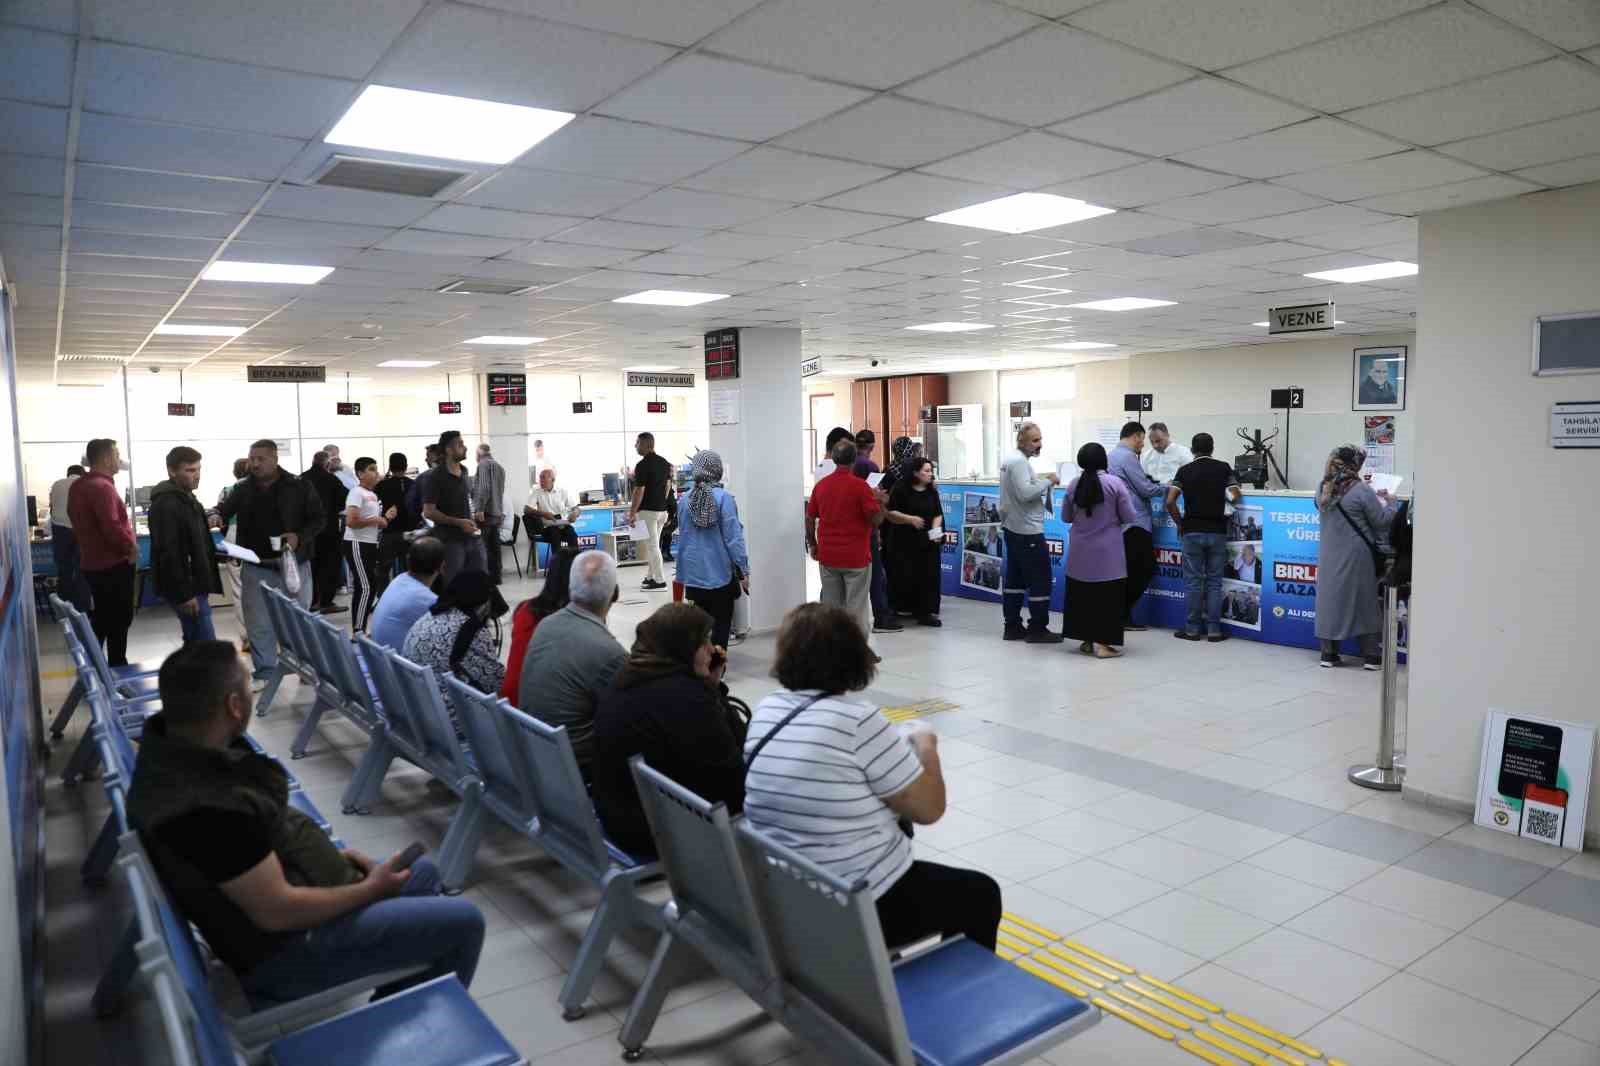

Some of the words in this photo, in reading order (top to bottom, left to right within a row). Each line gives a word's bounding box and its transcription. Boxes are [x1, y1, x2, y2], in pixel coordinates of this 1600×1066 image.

[1278, 310, 1325, 327] VEZNE
[802, 361, 818, 374] EZNE
[1143, 398, 1149, 407] 3
[1293, 393, 1300, 404] 2
[1269, 511, 1320, 525] TEŞEKK
[577, 536, 597, 545] KTE
[1287, 527, 1320, 541] YÜRE
[1046, 541, 1062, 553] TE
[1276, 582, 1317, 596] KAZA
